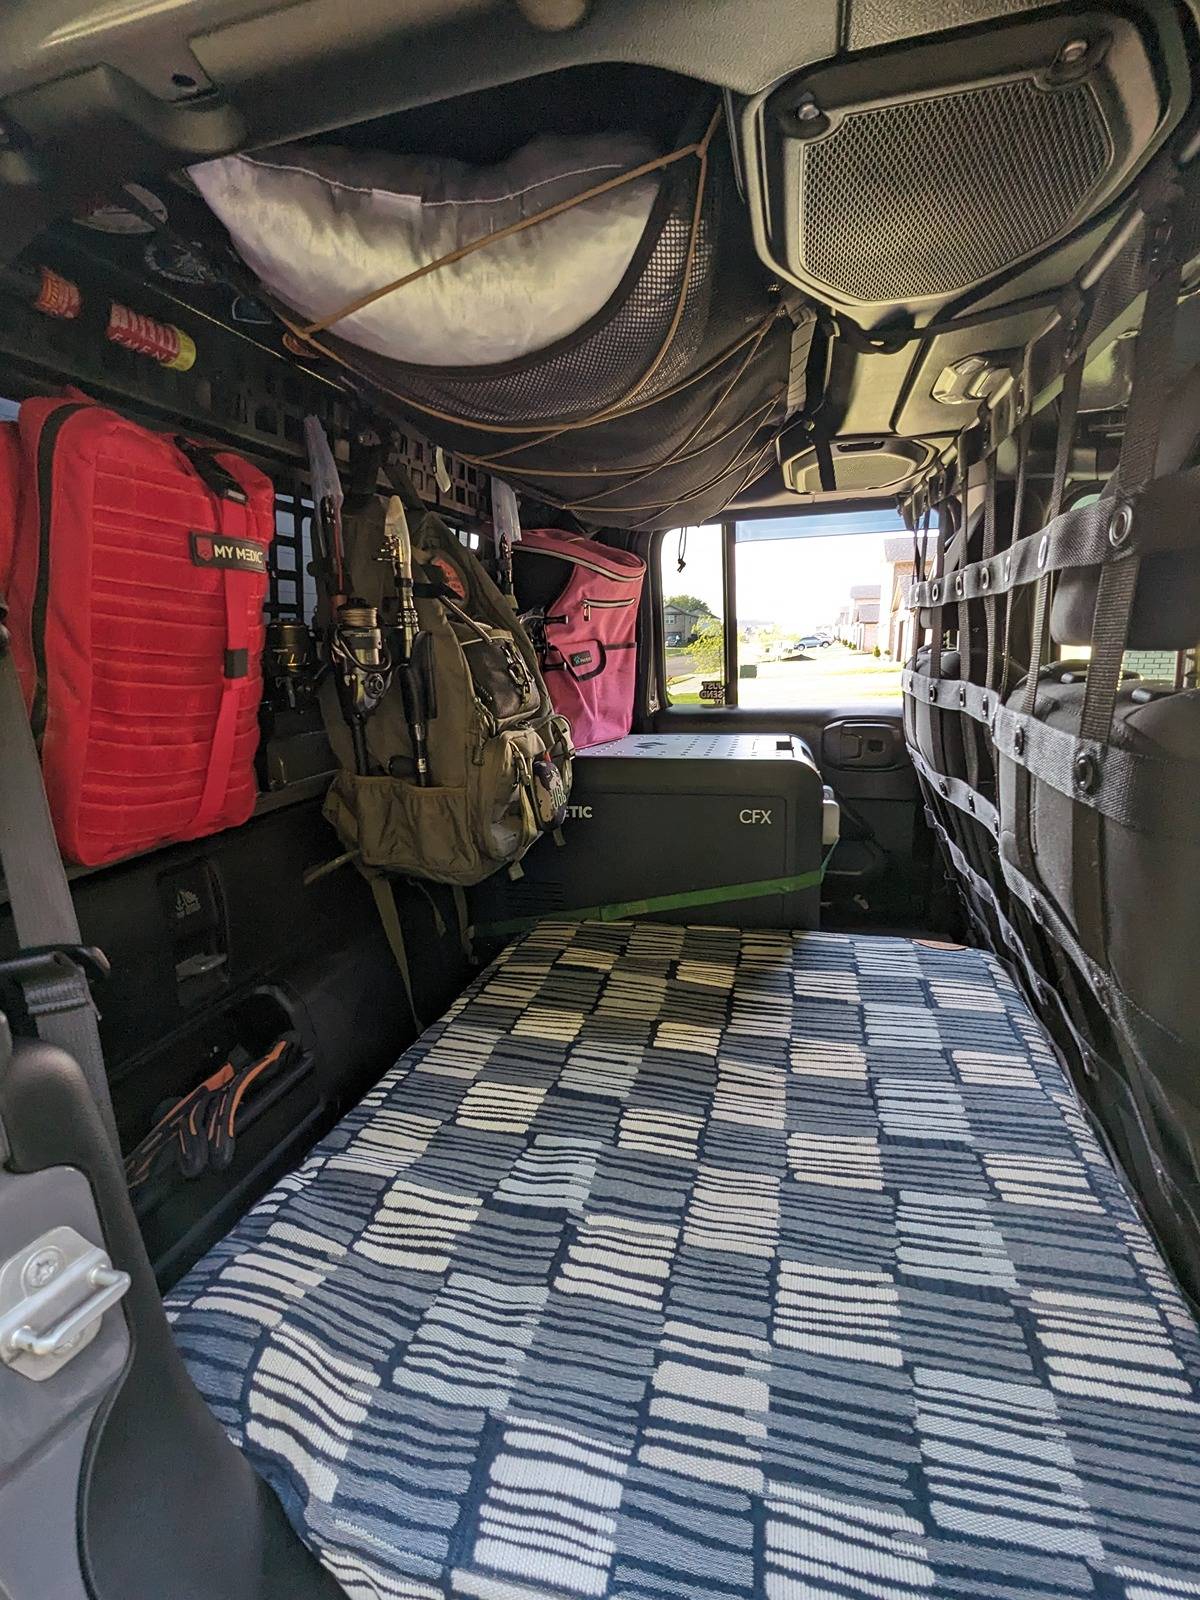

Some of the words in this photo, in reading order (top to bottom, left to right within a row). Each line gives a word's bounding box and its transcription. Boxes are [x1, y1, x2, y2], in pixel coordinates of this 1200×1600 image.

[213, 544, 234, 559] MY
[235, 547, 263, 563] MEDIC
[739, 809, 772, 824] CFX
